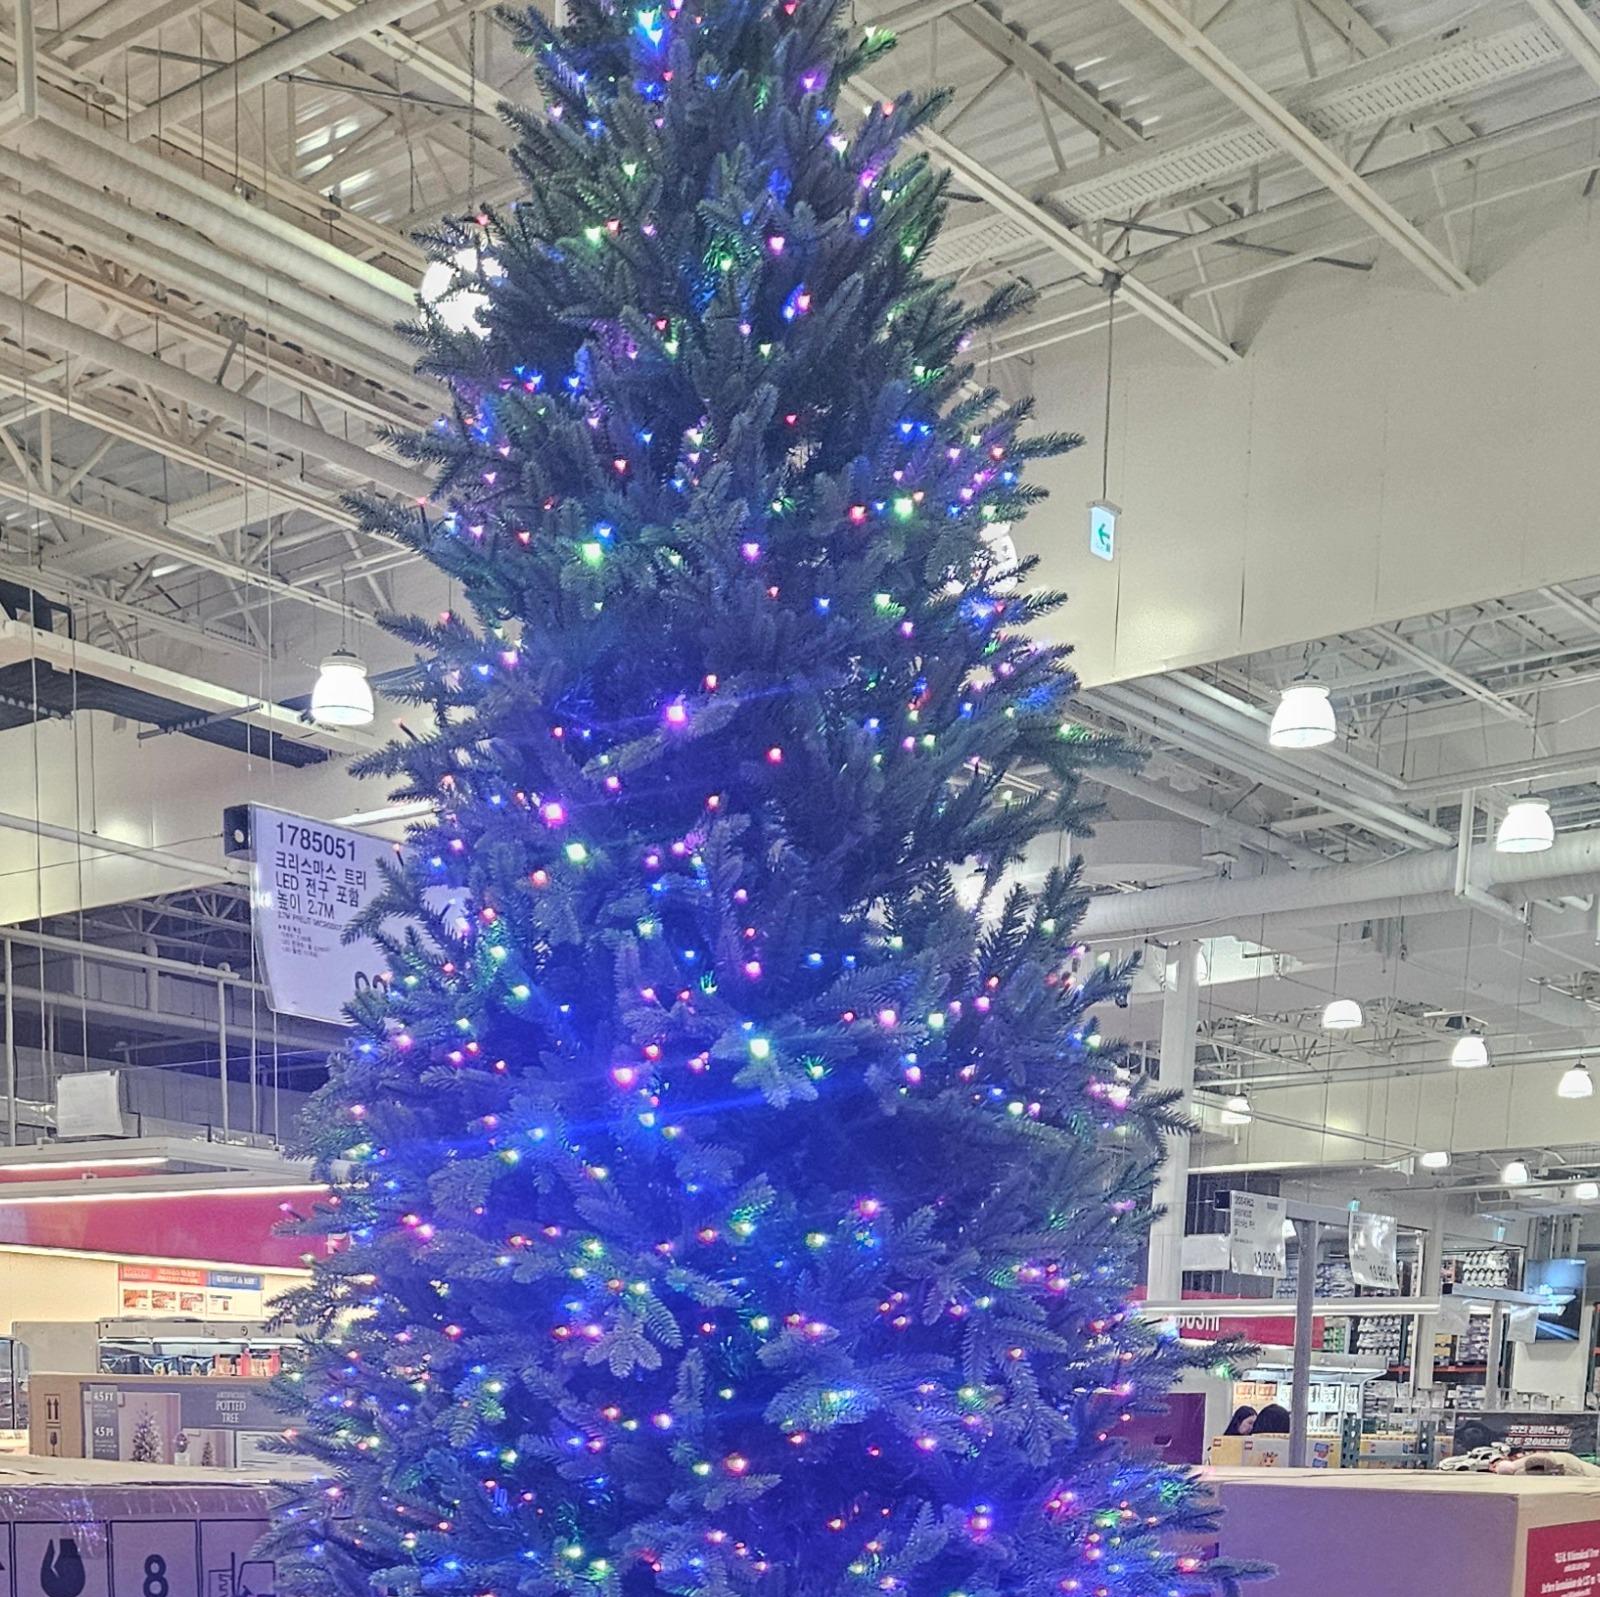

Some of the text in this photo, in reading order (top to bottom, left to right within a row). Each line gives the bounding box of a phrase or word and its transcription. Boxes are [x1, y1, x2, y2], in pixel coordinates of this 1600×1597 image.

[276, 821, 355, 862] 1785051
[275, 850, 367, 891] 크리스마스 트리
[276, 871, 360, 908] LED 전구 포함
[277, 889, 335, 920] 높이 2.7M
[215, 1400, 247, 1411] POTTED
[221, 1412, 240, 1424] TREE
